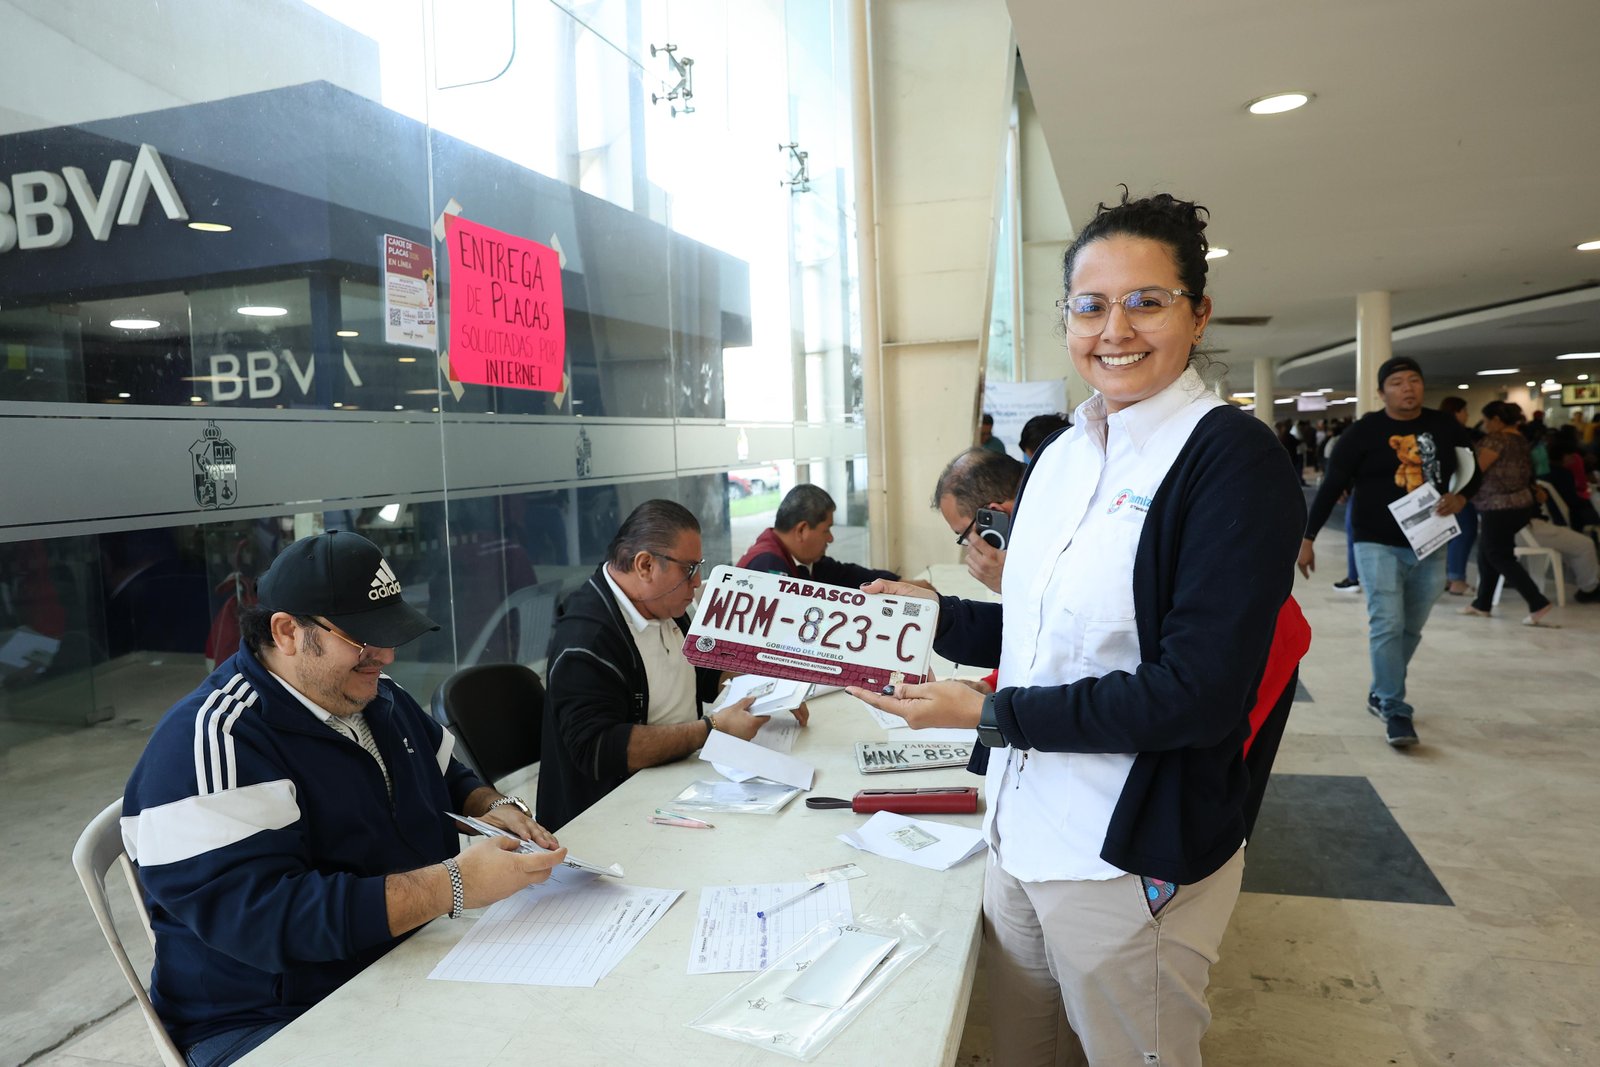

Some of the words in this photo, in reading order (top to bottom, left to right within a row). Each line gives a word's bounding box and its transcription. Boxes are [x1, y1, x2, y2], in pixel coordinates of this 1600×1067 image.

[388, 238, 405, 248] CANJE
[406, 242, 413, 250] DE
[388, 246, 409, 258] PLACAS
[388, 258, 397, 266] EN
[459, 231, 545, 292] ENTREGA
[467, 284, 484, 316] DE
[461, 324, 534, 358] SOLICITADAS
[539, 338, 557, 367] POR
[485, 359, 543, 387] INTERNET
[722, 573, 733, 583] F
[778, 580, 866, 606] TABASCO
[701, 587, 922, 663] WRM-823-C
[762, 655, 790, 663] TRANSPORTE
[766, 642, 802, 653] GOBIERNO
[802, 648, 815, 656] DEL
[816, 651, 844, 661] PUEBLO
